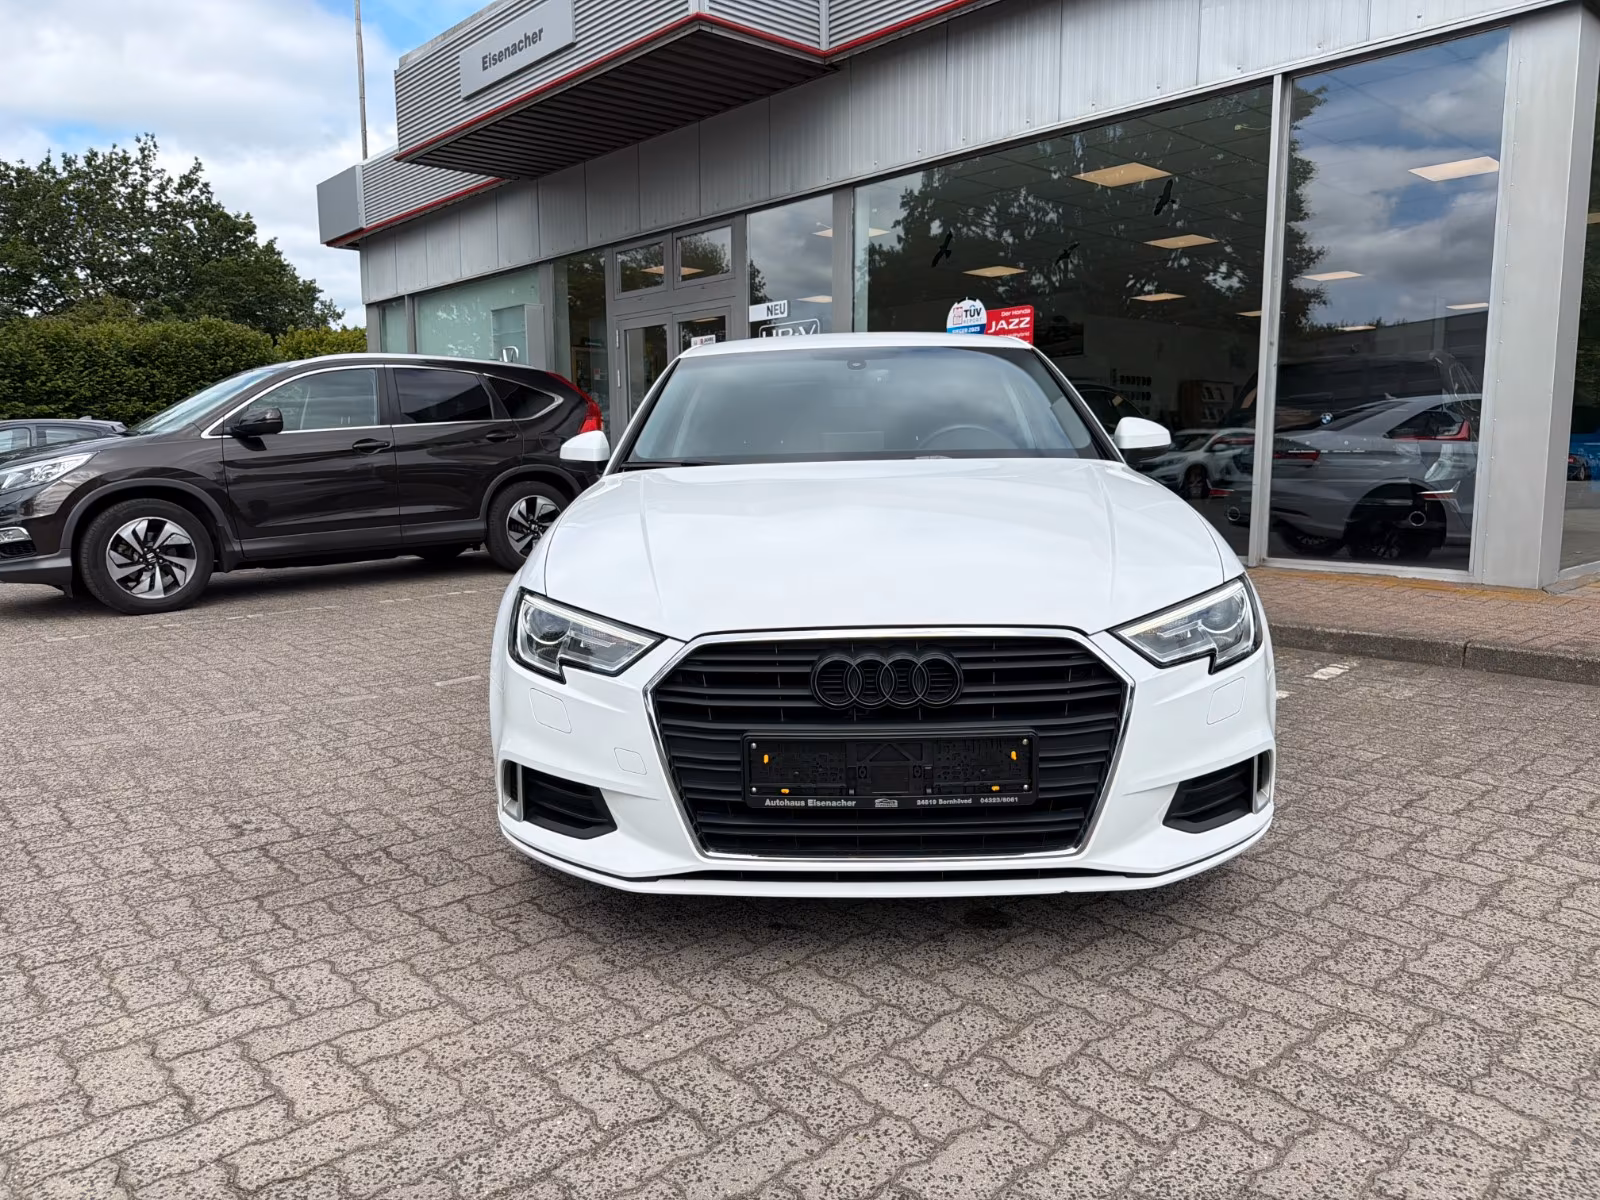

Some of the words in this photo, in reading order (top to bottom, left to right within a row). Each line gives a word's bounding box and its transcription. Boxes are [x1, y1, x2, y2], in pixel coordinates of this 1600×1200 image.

[481, 27, 544, 72] Eisenacher
[766, 302, 786, 317] NEU
[964, 305, 982, 319] TÜV
[987, 316, 1031, 333] JAZZ
[764, 798, 806, 807] Autohaus
[807, 799, 857, 807] Eisenacher
